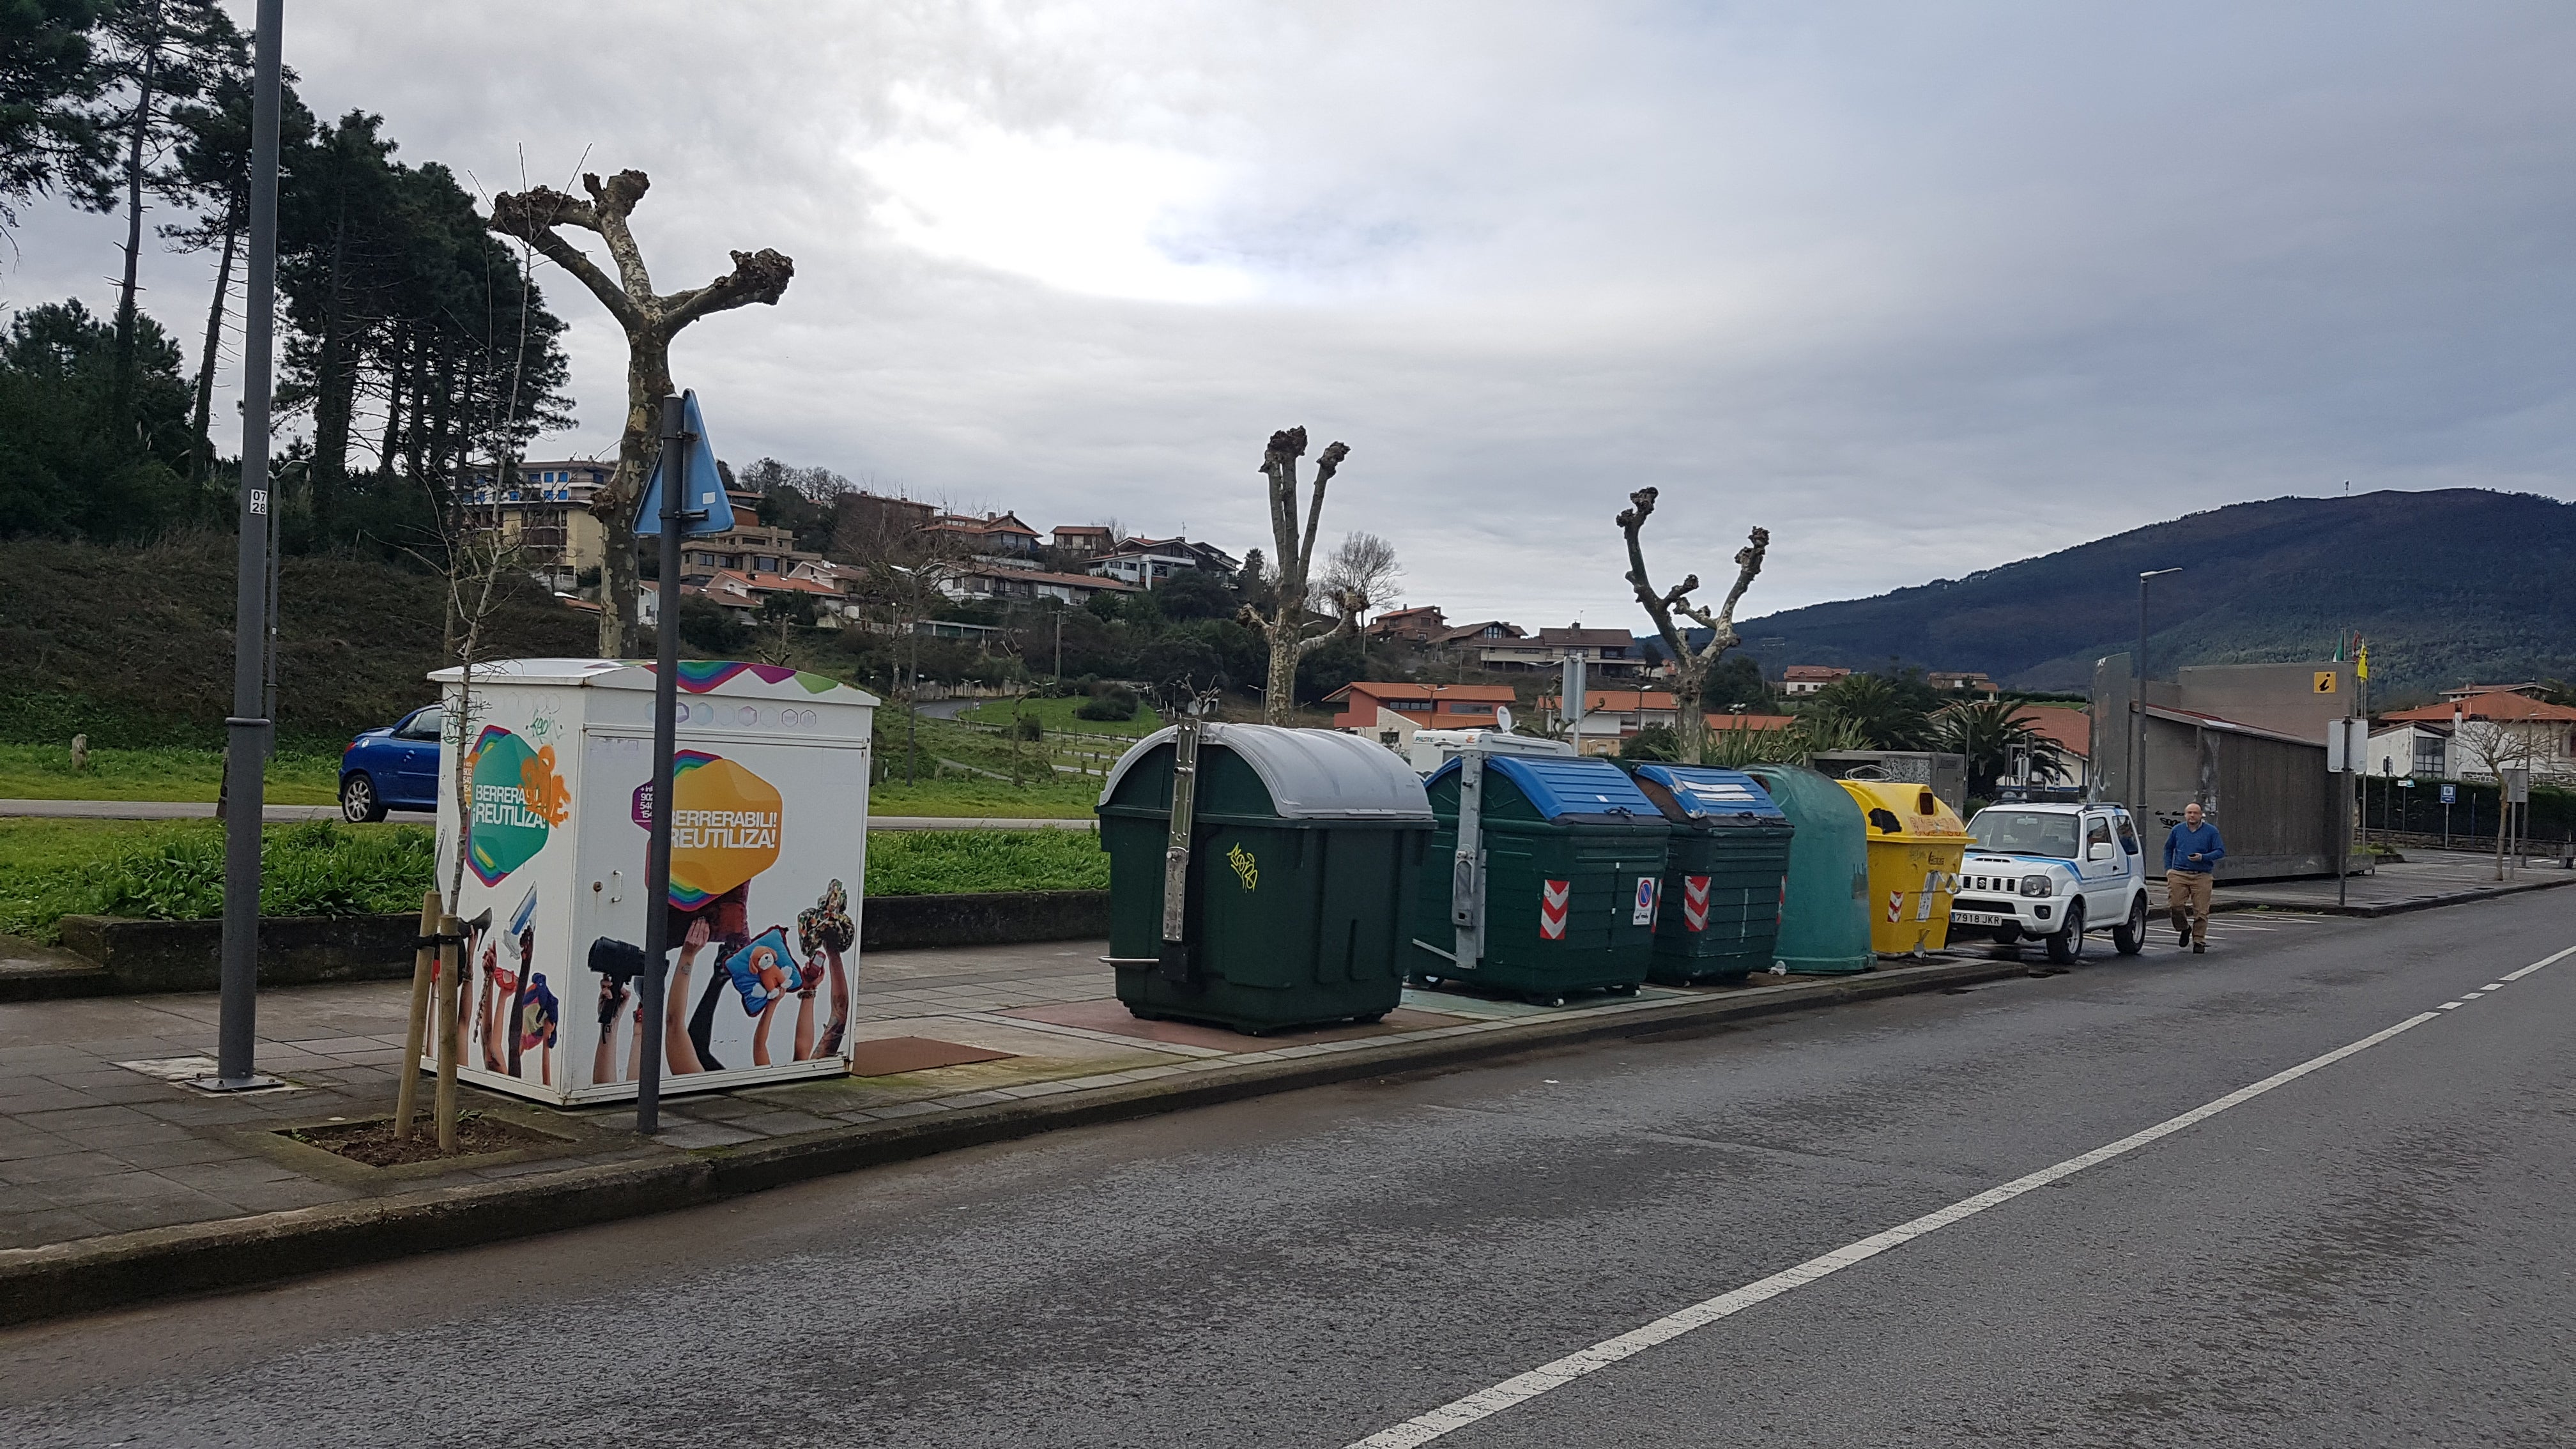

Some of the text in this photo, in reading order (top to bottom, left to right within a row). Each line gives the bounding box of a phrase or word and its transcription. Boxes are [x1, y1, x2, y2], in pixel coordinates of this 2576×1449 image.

[253, 491, 266, 502] 07
[252, 503, 266, 513] 28
[1956, 914, 1999, 924] 7918 JKR
